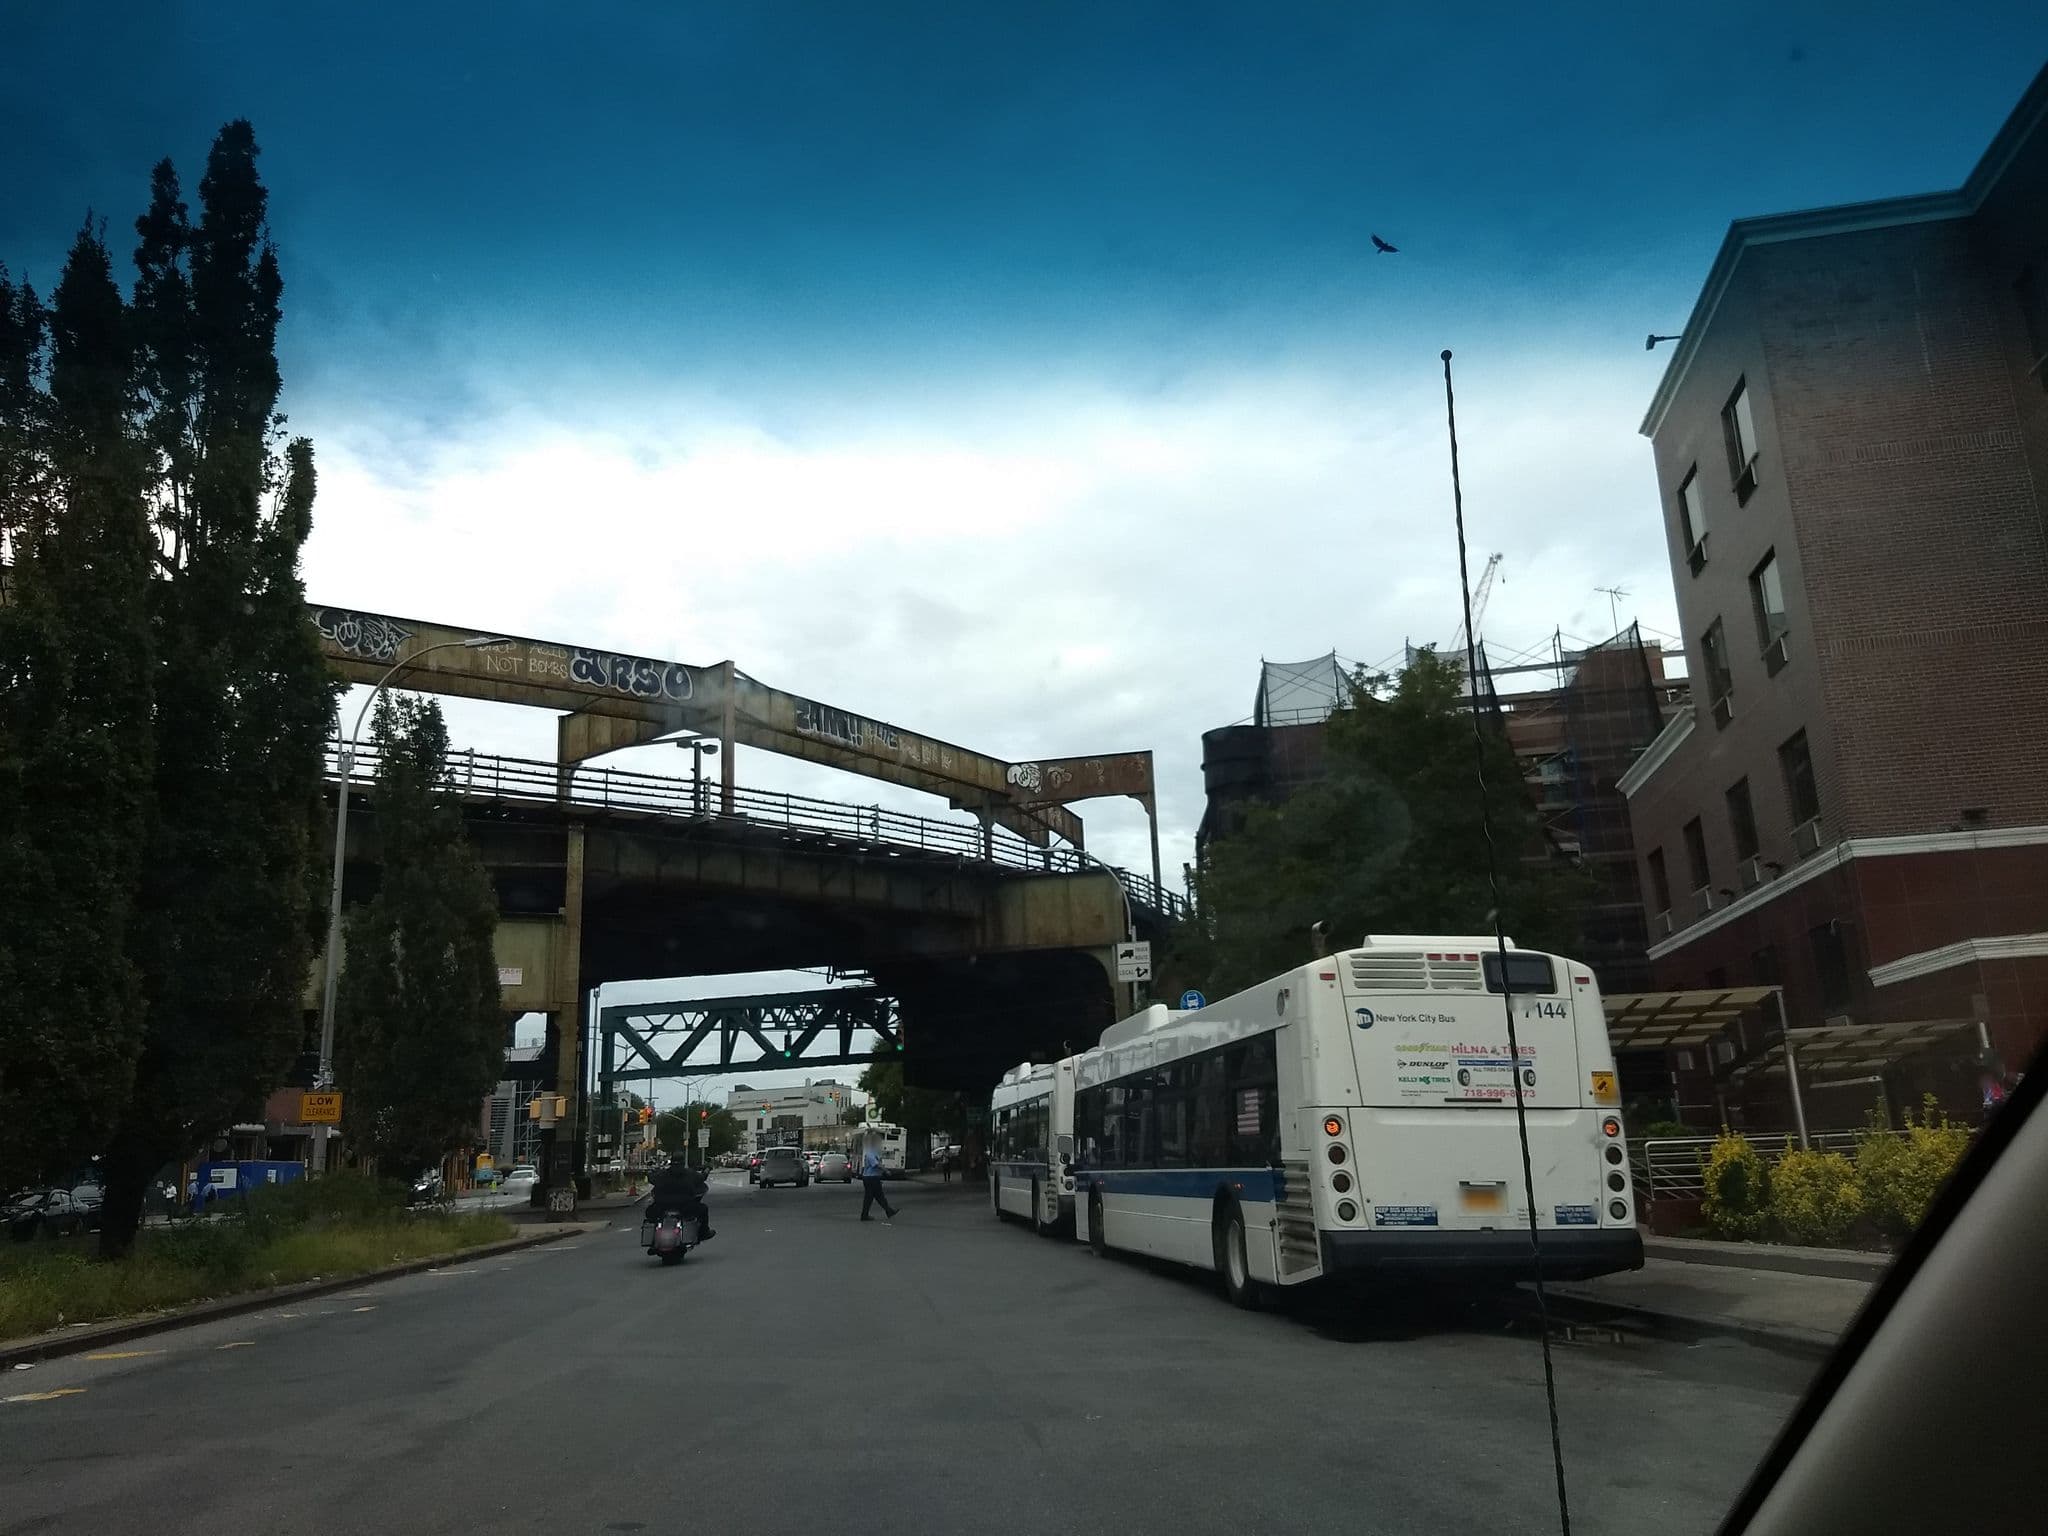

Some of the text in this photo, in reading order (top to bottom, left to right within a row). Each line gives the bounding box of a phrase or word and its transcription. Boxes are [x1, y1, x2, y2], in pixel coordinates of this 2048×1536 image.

[486, 655, 569, 679] NOT BOMBS
[1376, 1014, 1456, 1024] New York City Bus
[1464, 1088, 1536, 1098] 718-996-873
[309, 1097, 334, 1105] LOW
[305, 1107, 337, 1116] CLEARANCE
